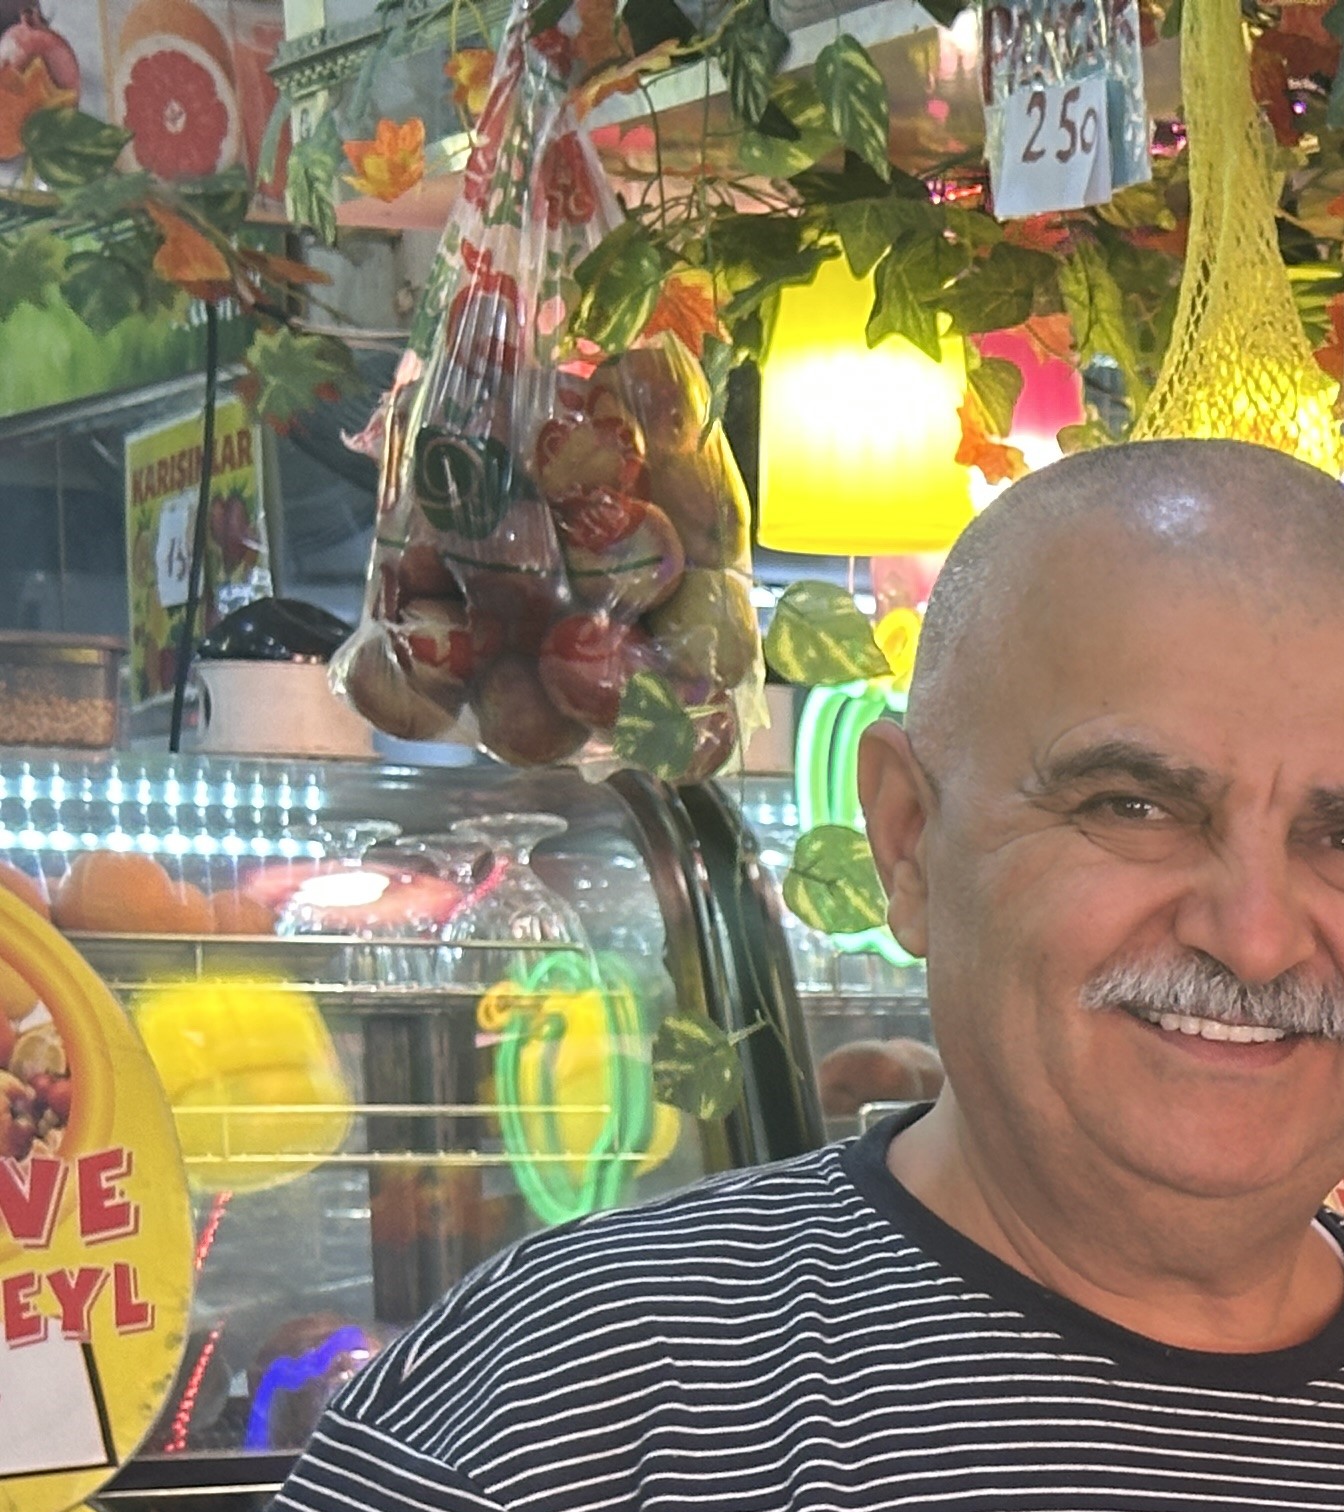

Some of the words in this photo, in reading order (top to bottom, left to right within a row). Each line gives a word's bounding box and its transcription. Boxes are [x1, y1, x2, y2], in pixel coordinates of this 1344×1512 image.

[1021, 86, 1097, 164] 250
[0, 1146, 140, 1248] VE
[1, 1262, 156, 1349] EYL
